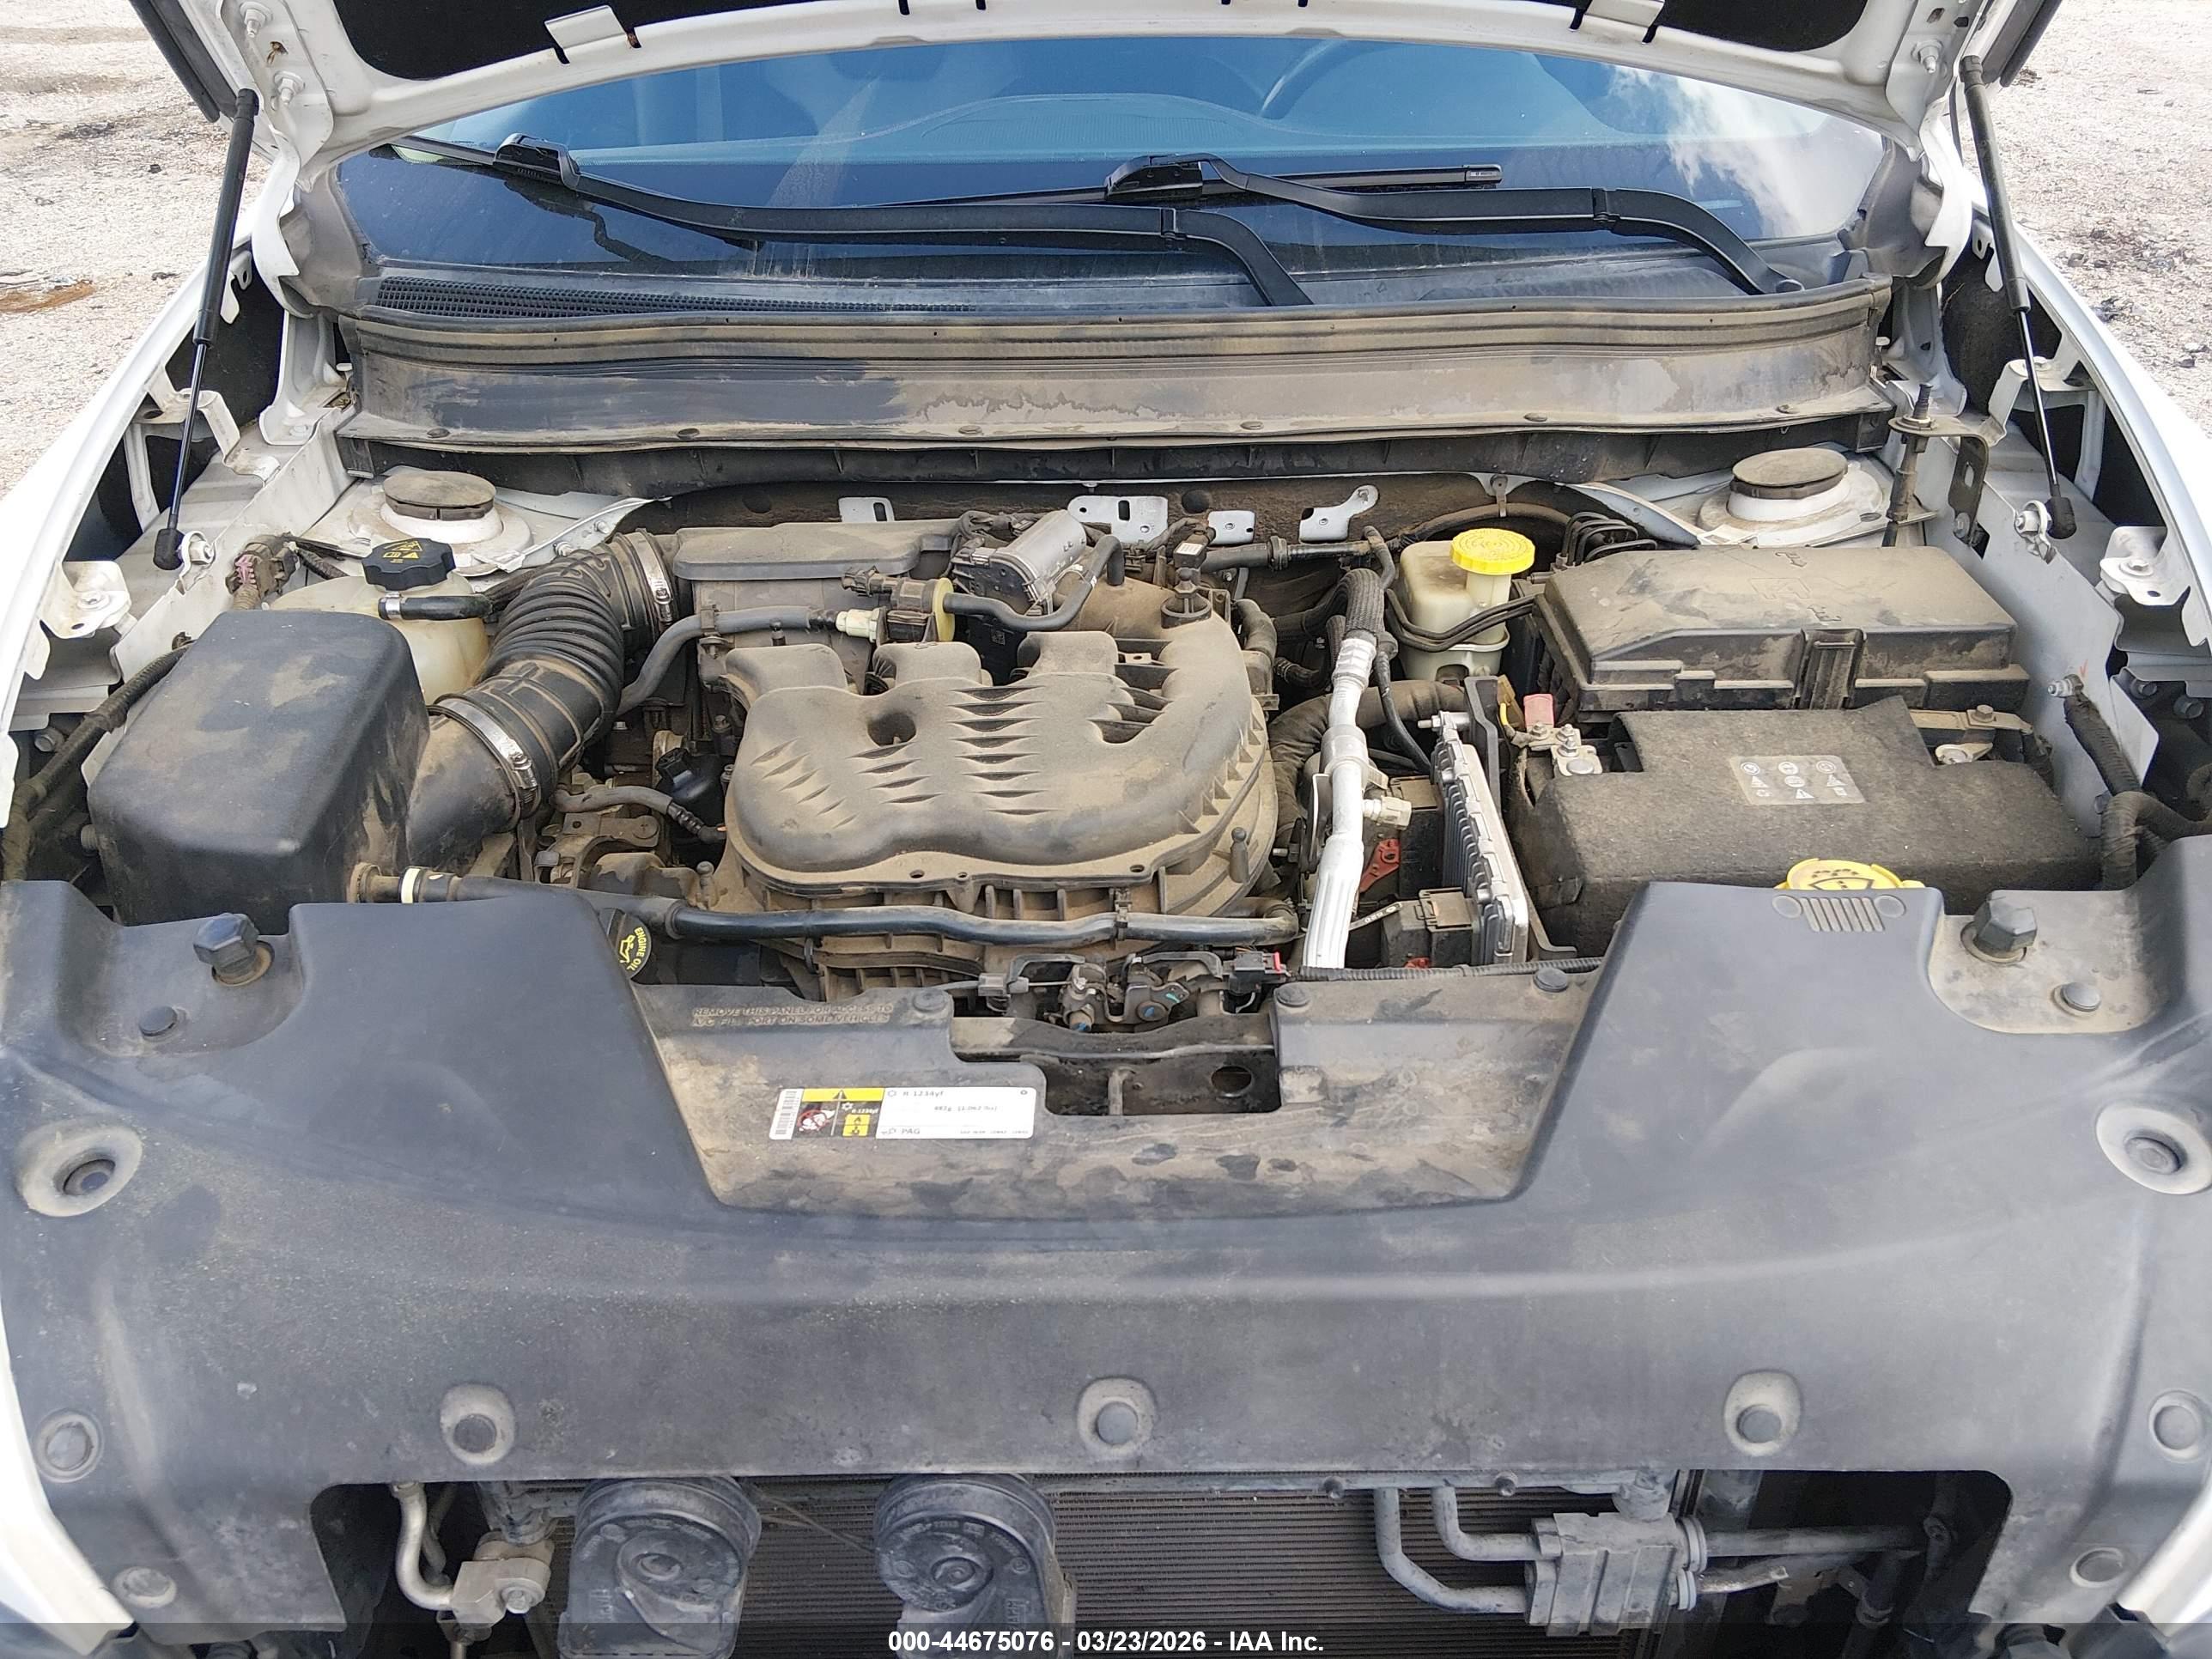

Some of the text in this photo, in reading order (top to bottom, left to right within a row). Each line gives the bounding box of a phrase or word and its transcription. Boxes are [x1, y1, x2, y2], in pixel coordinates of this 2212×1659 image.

[626, 927, 647, 971] ENGINE OIL
[692, 1007, 740, 1017] REMOVE
[742, 1006, 769, 1016] THIS
[769, 1005, 805, 1016] PANEL
[878, 1004, 894, 1013] TO
[692, 1017, 715, 1027] A/C
[748, 1016, 778, 1025] PORT
[779, 1016, 796, 1025] ON
[799, 1015, 831, 1025] SOME
